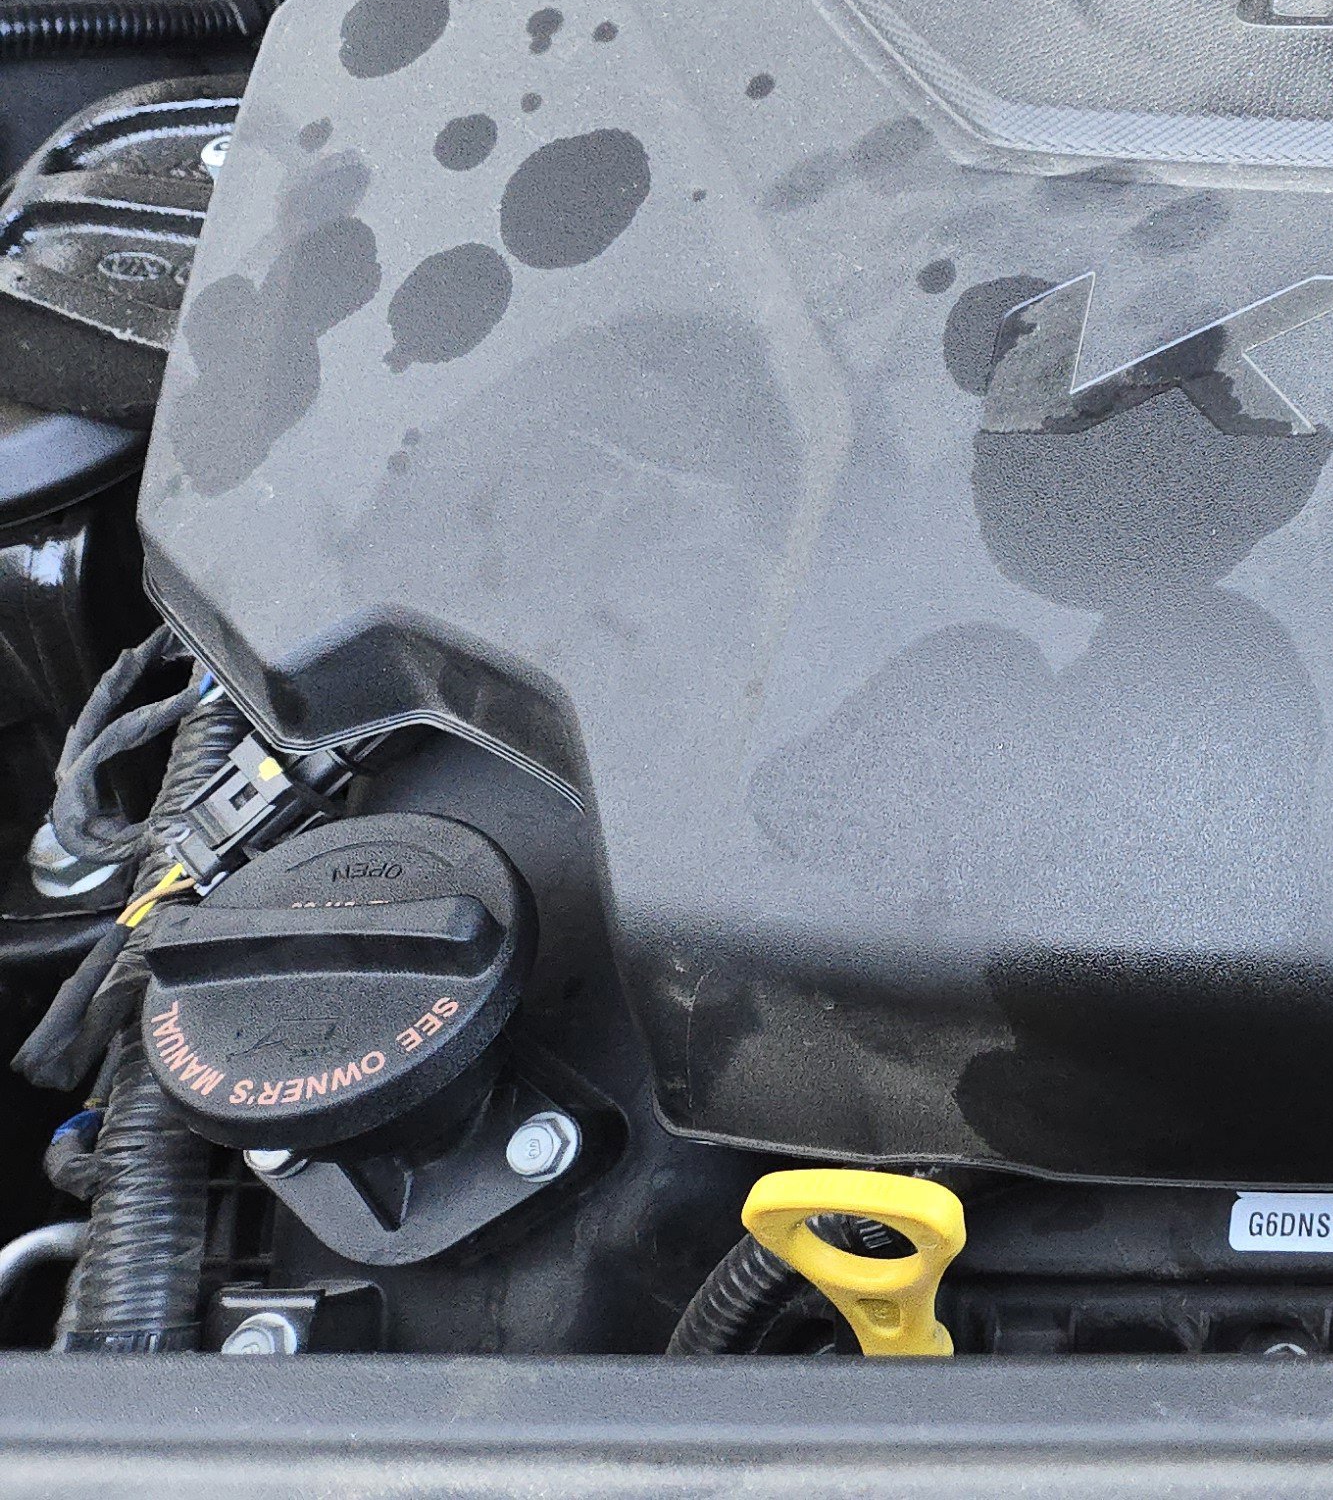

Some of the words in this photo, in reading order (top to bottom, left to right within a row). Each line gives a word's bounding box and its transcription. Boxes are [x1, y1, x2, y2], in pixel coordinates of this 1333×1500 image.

[331, 862, 403, 883] OPEN
[151, 1001, 226, 1097] MANUAL
[396, 996, 459, 1053] SEE
[229, 1051, 385, 1105] OWNER'S
